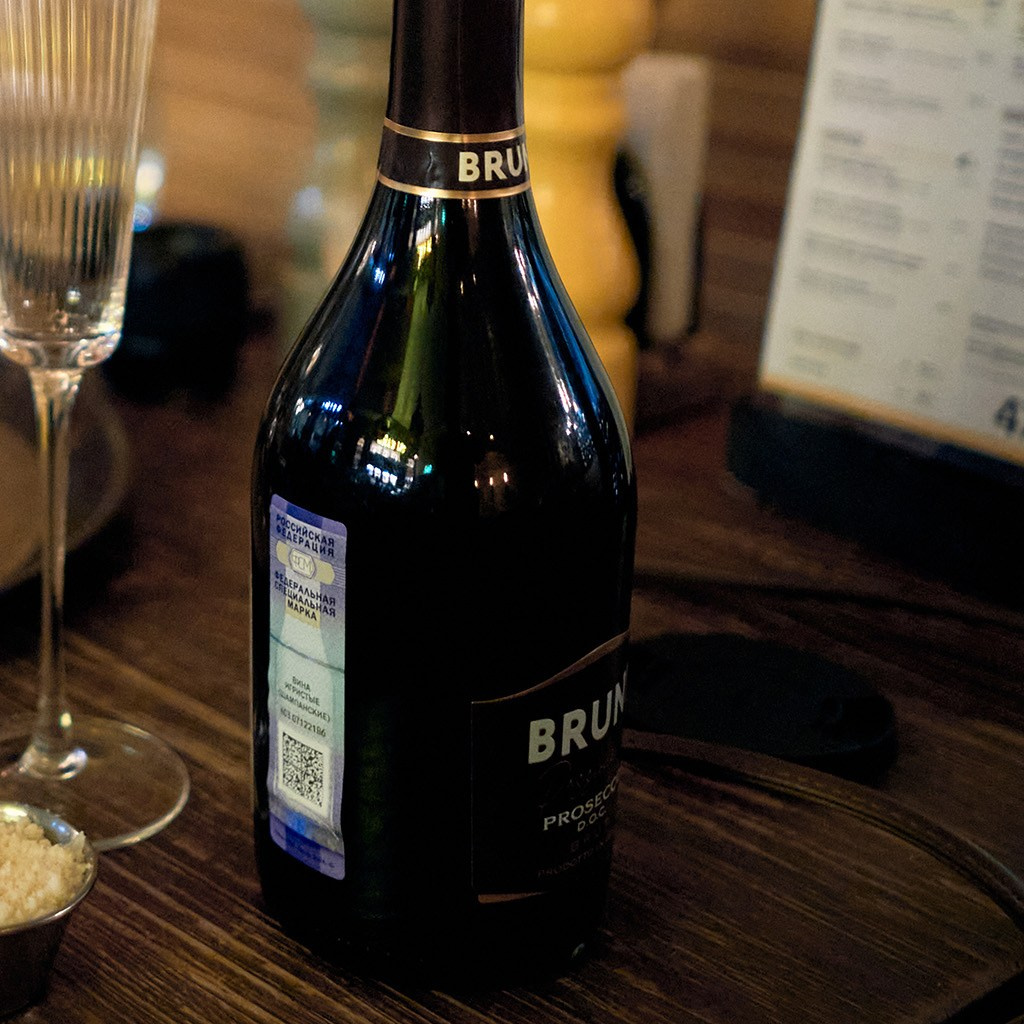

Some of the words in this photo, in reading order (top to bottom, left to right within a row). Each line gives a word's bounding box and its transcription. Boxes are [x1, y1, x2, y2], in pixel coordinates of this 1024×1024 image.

[276, 514, 335, 547] РОССИЙСКАЯ
[276, 525, 334, 557] ФЕДЕРАЦИЯ
[274, 571, 337, 606] ФЕДЕРАЛЬНАЯ
[274, 580, 337, 617] СПЕЦИАЛЬНАЯ
[287, 599, 318, 621] МАРКА
